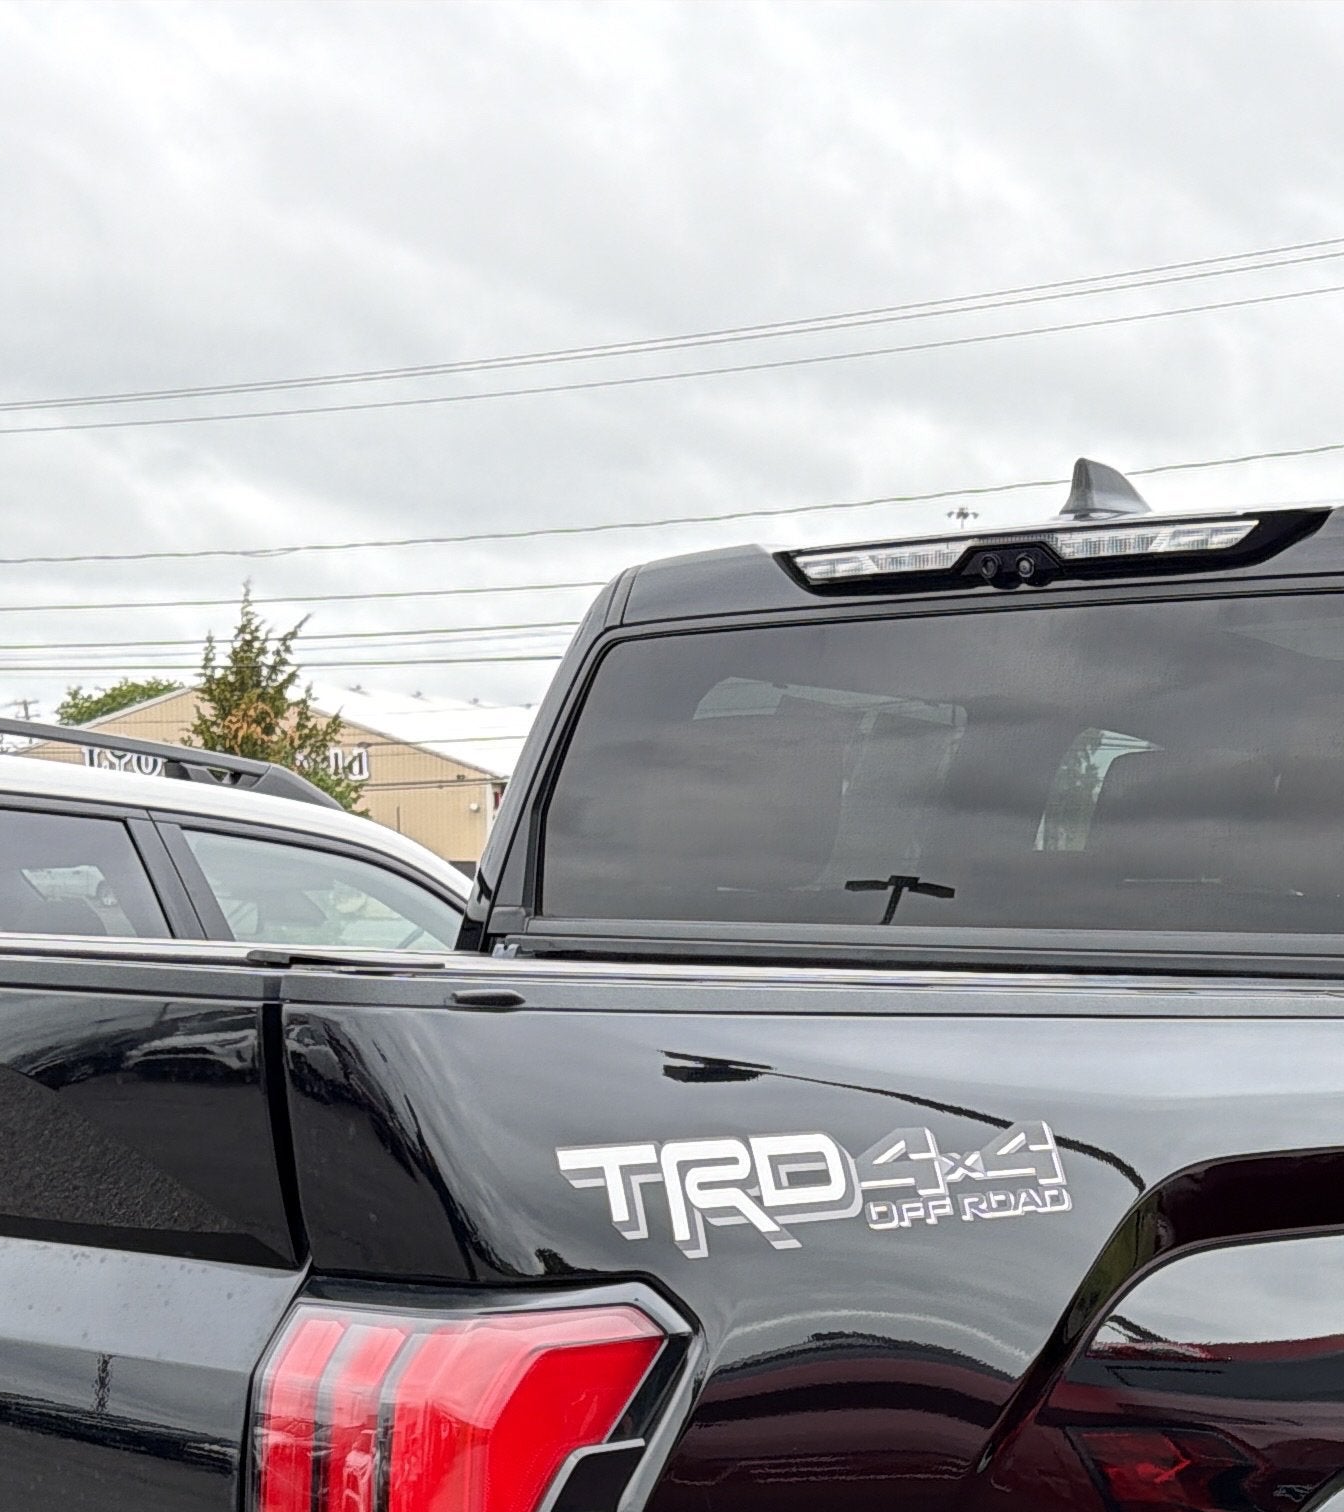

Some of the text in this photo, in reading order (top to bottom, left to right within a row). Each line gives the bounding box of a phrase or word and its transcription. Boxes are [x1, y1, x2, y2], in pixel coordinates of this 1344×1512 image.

[556, 1120, 1067, 1260] TRD 4x4
[865, 1186, 1073, 1231] OFF ROAD
